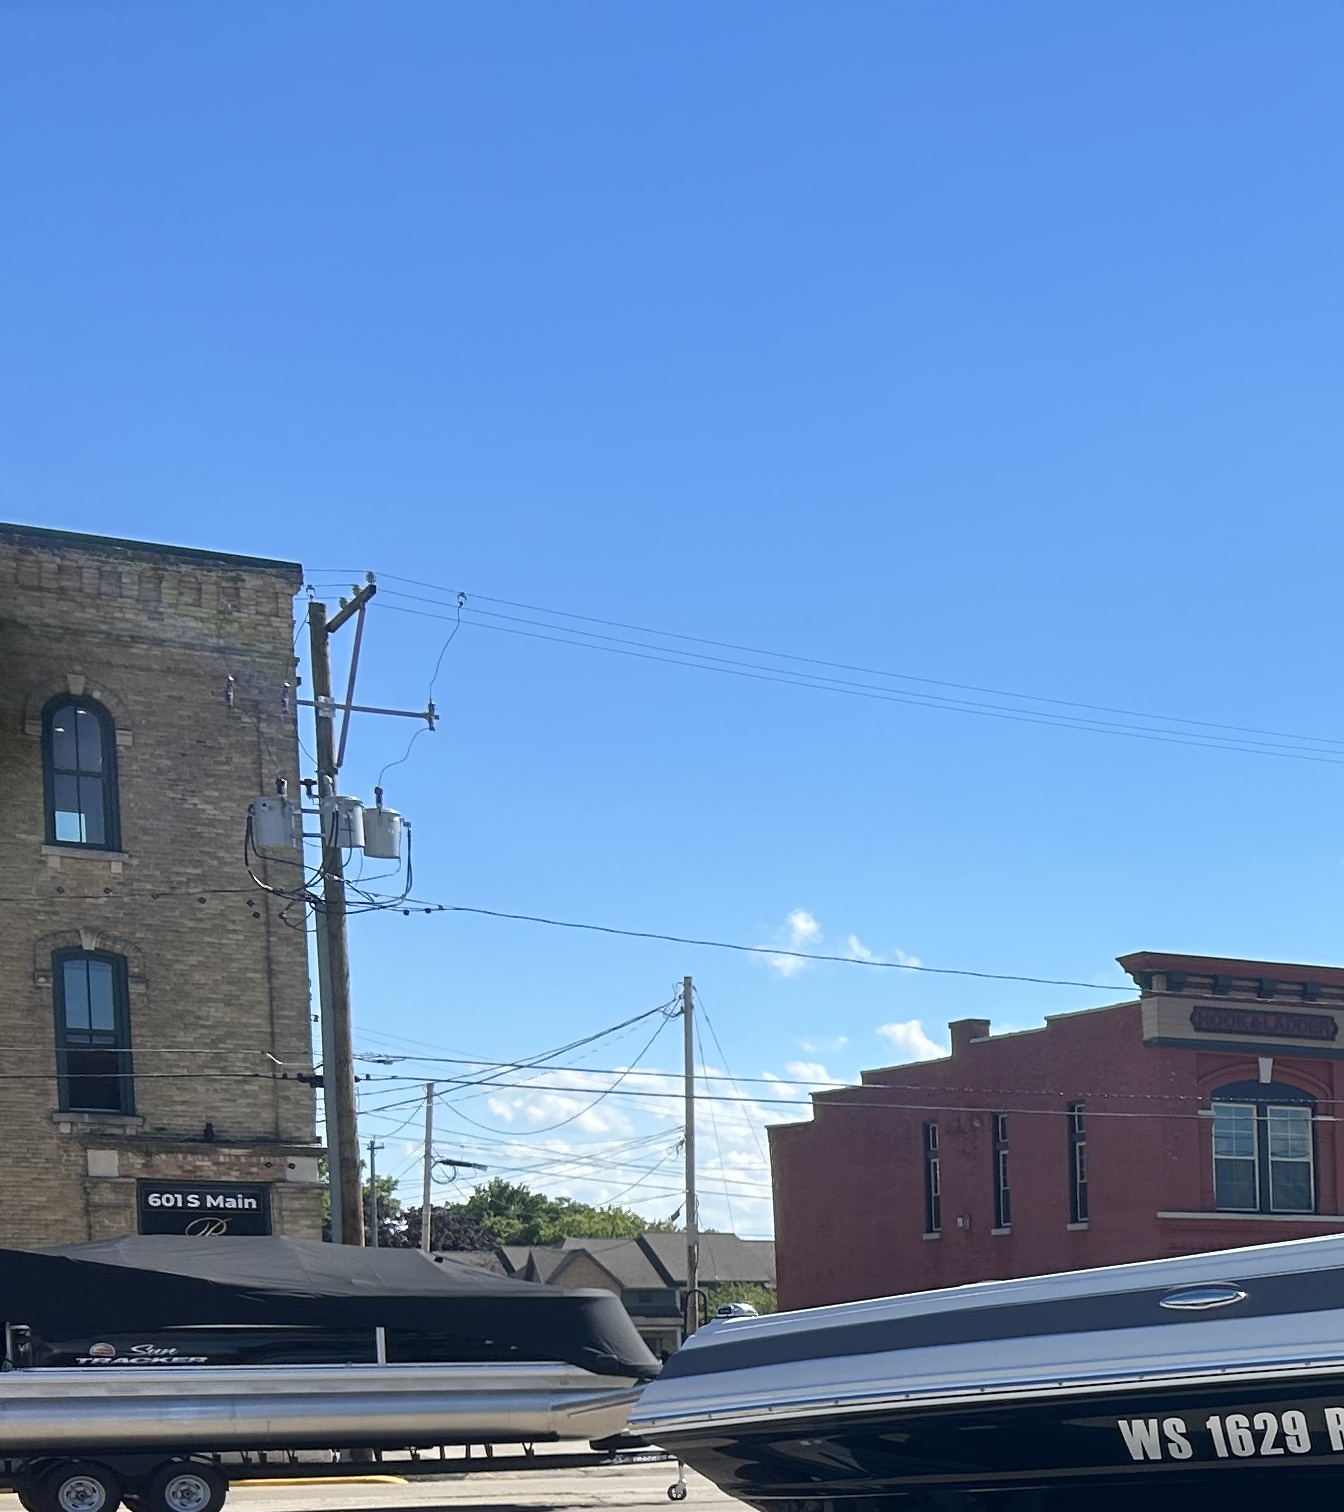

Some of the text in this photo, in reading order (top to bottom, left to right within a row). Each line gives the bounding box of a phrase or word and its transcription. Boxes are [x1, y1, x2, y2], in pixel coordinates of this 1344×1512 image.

[147, 1193, 257, 1209] 601 S Main
[76, 1356, 209, 1365] TRACKER
[1117, 1417, 1193, 1461] WS
[1205, 1410, 1312, 1458] 1629
